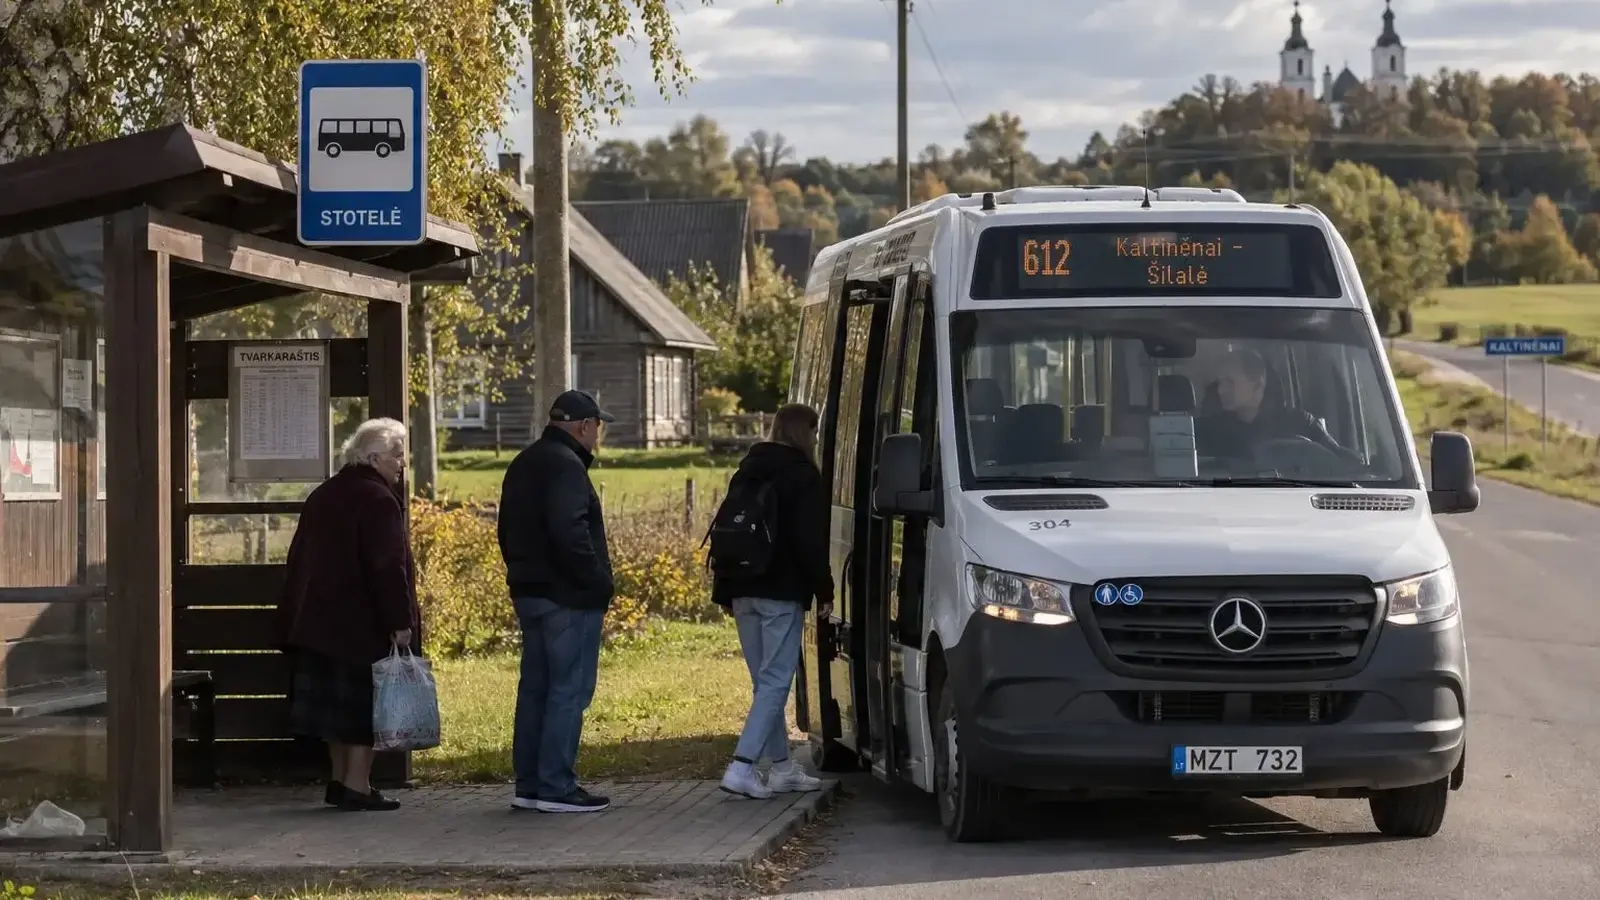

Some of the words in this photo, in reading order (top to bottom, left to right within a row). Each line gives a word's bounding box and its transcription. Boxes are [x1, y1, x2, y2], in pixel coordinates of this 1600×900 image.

[320, 206, 402, 226] STOTELĖ
[1023, 239, 1071, 276] 612
[239, 349, 320, 362] TVARKARAŠTIS
[1028, 518, 1072, 531] 304
[1190, 749, 1238, 771] MZT
[1256, 749, 1298, 771] 732
